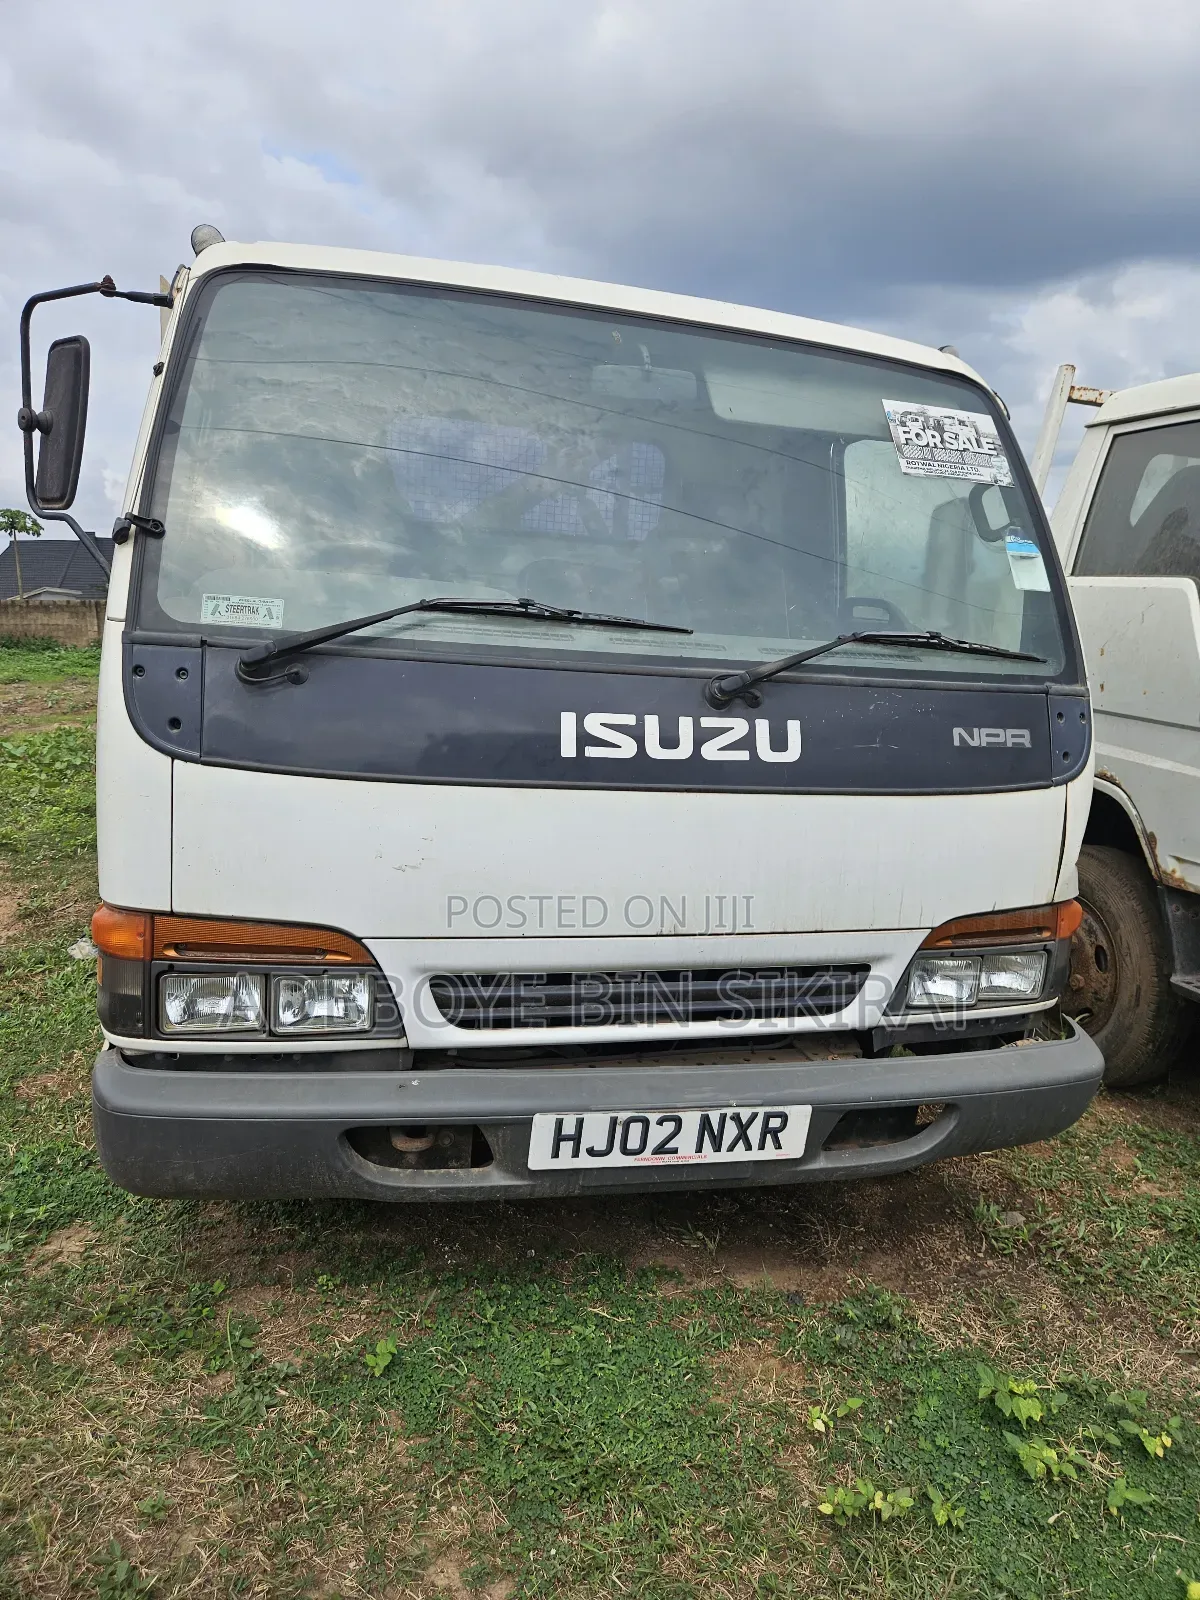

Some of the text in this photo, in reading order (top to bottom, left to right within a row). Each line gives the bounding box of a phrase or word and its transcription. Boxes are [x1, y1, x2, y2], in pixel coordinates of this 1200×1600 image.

[897, 426, 998, 456] FOR SALE
[937, 463, 966, 471] NIGERIA
[225, 604, 260, 615] STEERTRAK
[560, 711, 801, 763] ISUZU
[952, 727, 1032, 748] NPR
[550, 1111, 789, 1159] HJ02 NXR
